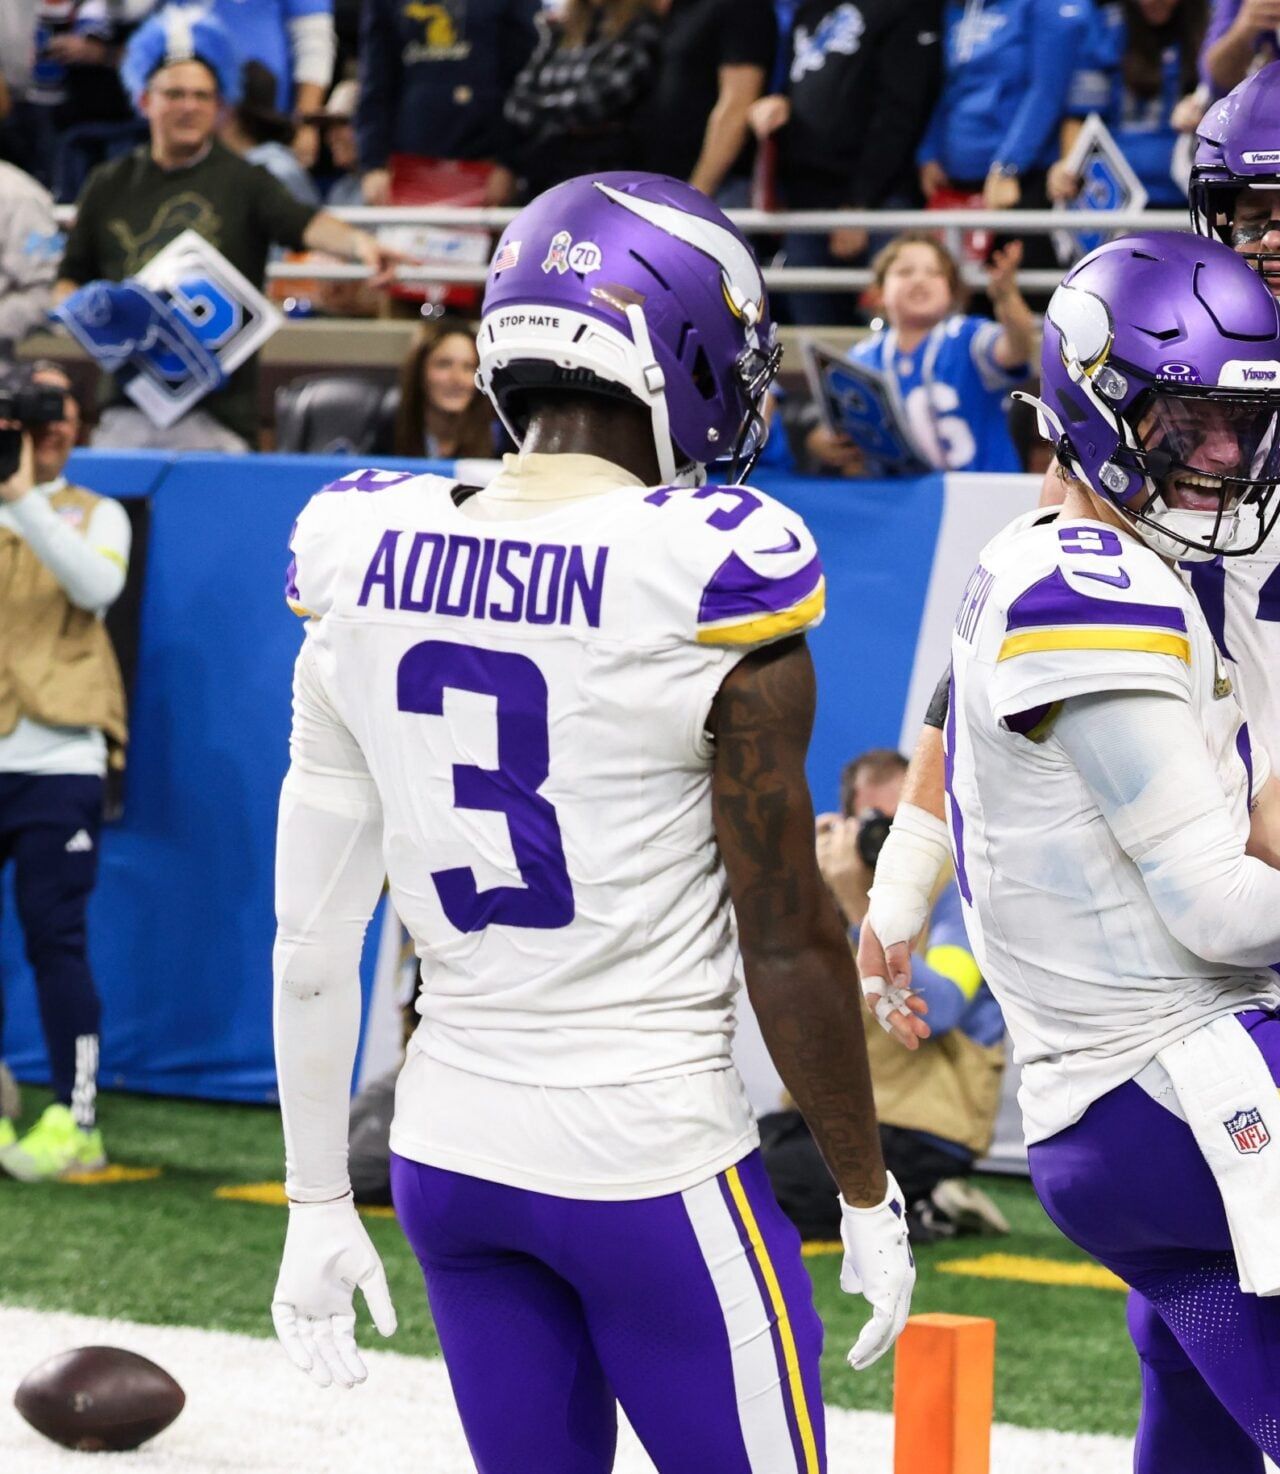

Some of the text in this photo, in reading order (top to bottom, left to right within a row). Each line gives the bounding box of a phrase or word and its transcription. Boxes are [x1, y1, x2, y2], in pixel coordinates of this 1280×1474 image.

[573, 248, 597, 266] 70
[499, 315, 560, 328] STOP HATE
[1155, 373, 1197, 382] OAKLEY
[357, 529, 609, 629] ADDISON
[397, 639, 575, 934] 3
[1234, 1125, 1267, 1150] NFL
